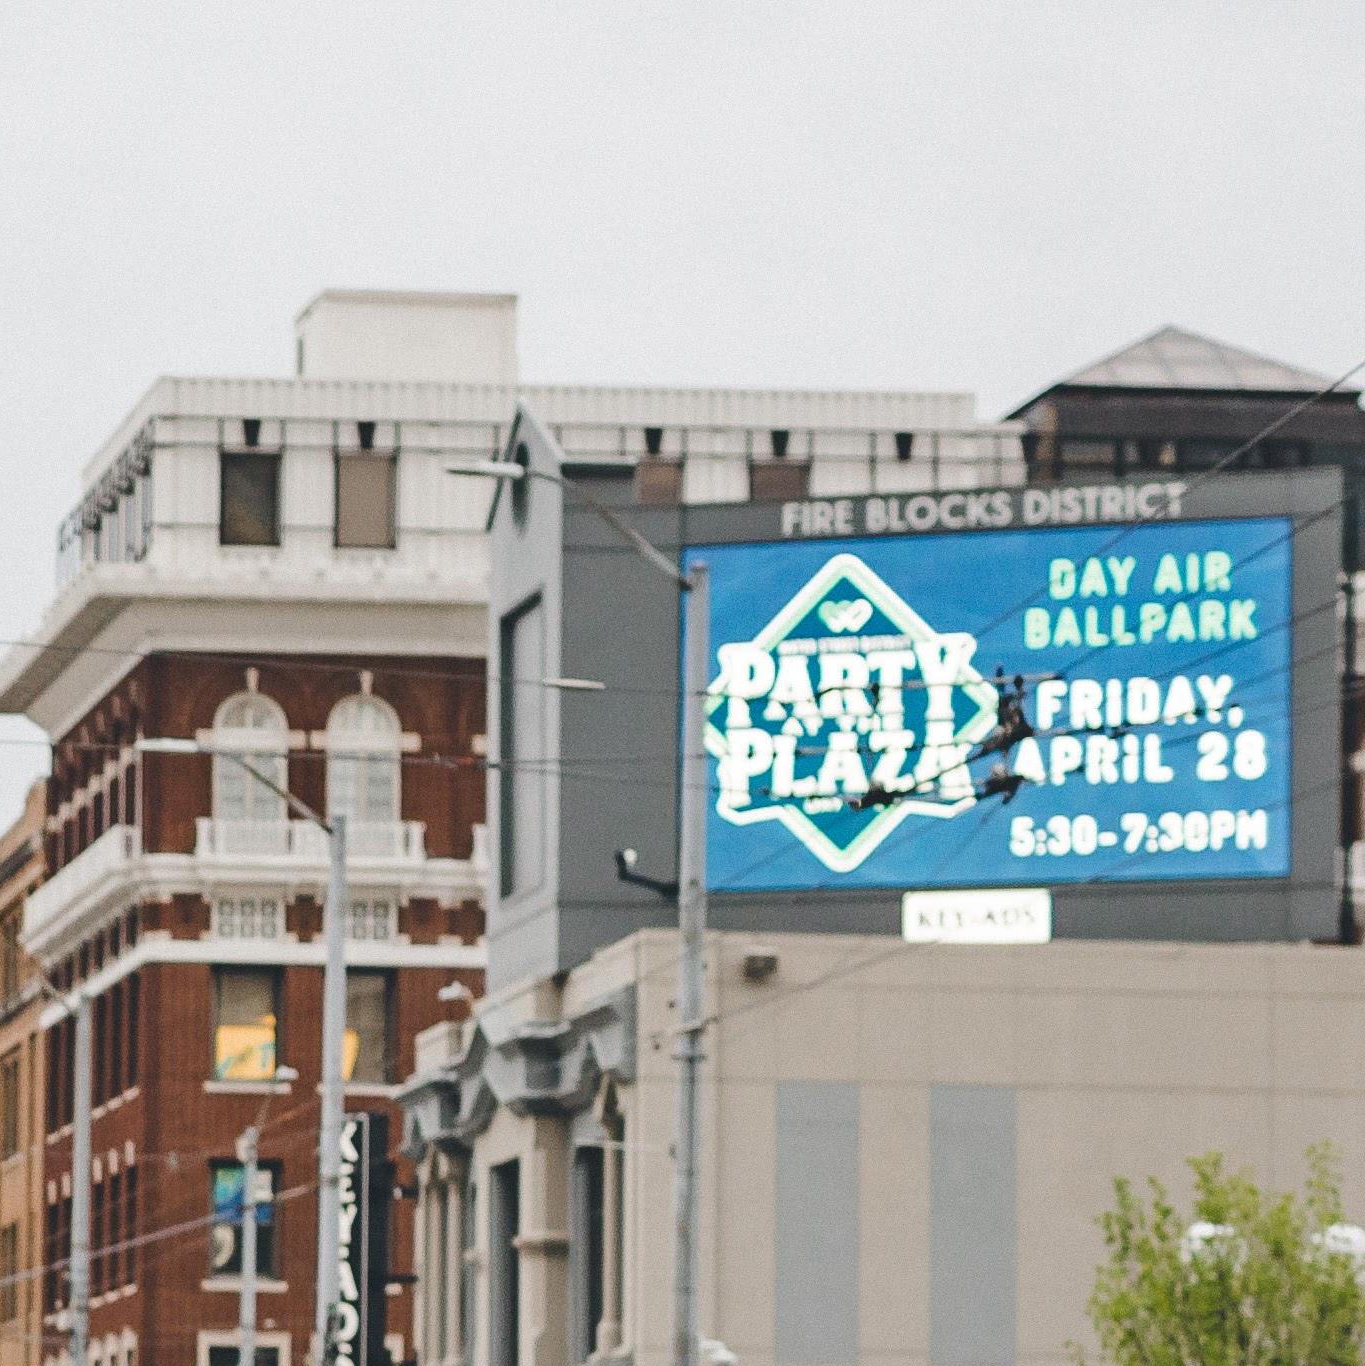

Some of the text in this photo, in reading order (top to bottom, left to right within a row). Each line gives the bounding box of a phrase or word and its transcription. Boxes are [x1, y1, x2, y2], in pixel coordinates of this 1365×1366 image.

[781, 481, 1187, 537] FIRE BLOCKS DISTRICT
[1049, 550, 1232, 600] DAY AIR
[1024, 599, 1258, 649] BALLPARK
[720, 632, 977, 728] PARTY
[1036, 674, 1244, 730] FRIDAY,
[717, 726, 975, 808] PLAZA
[1013, 729, 1267, 785] APRIL 28
[1010, 809, 1267, 857] 5:30-7:30PM
